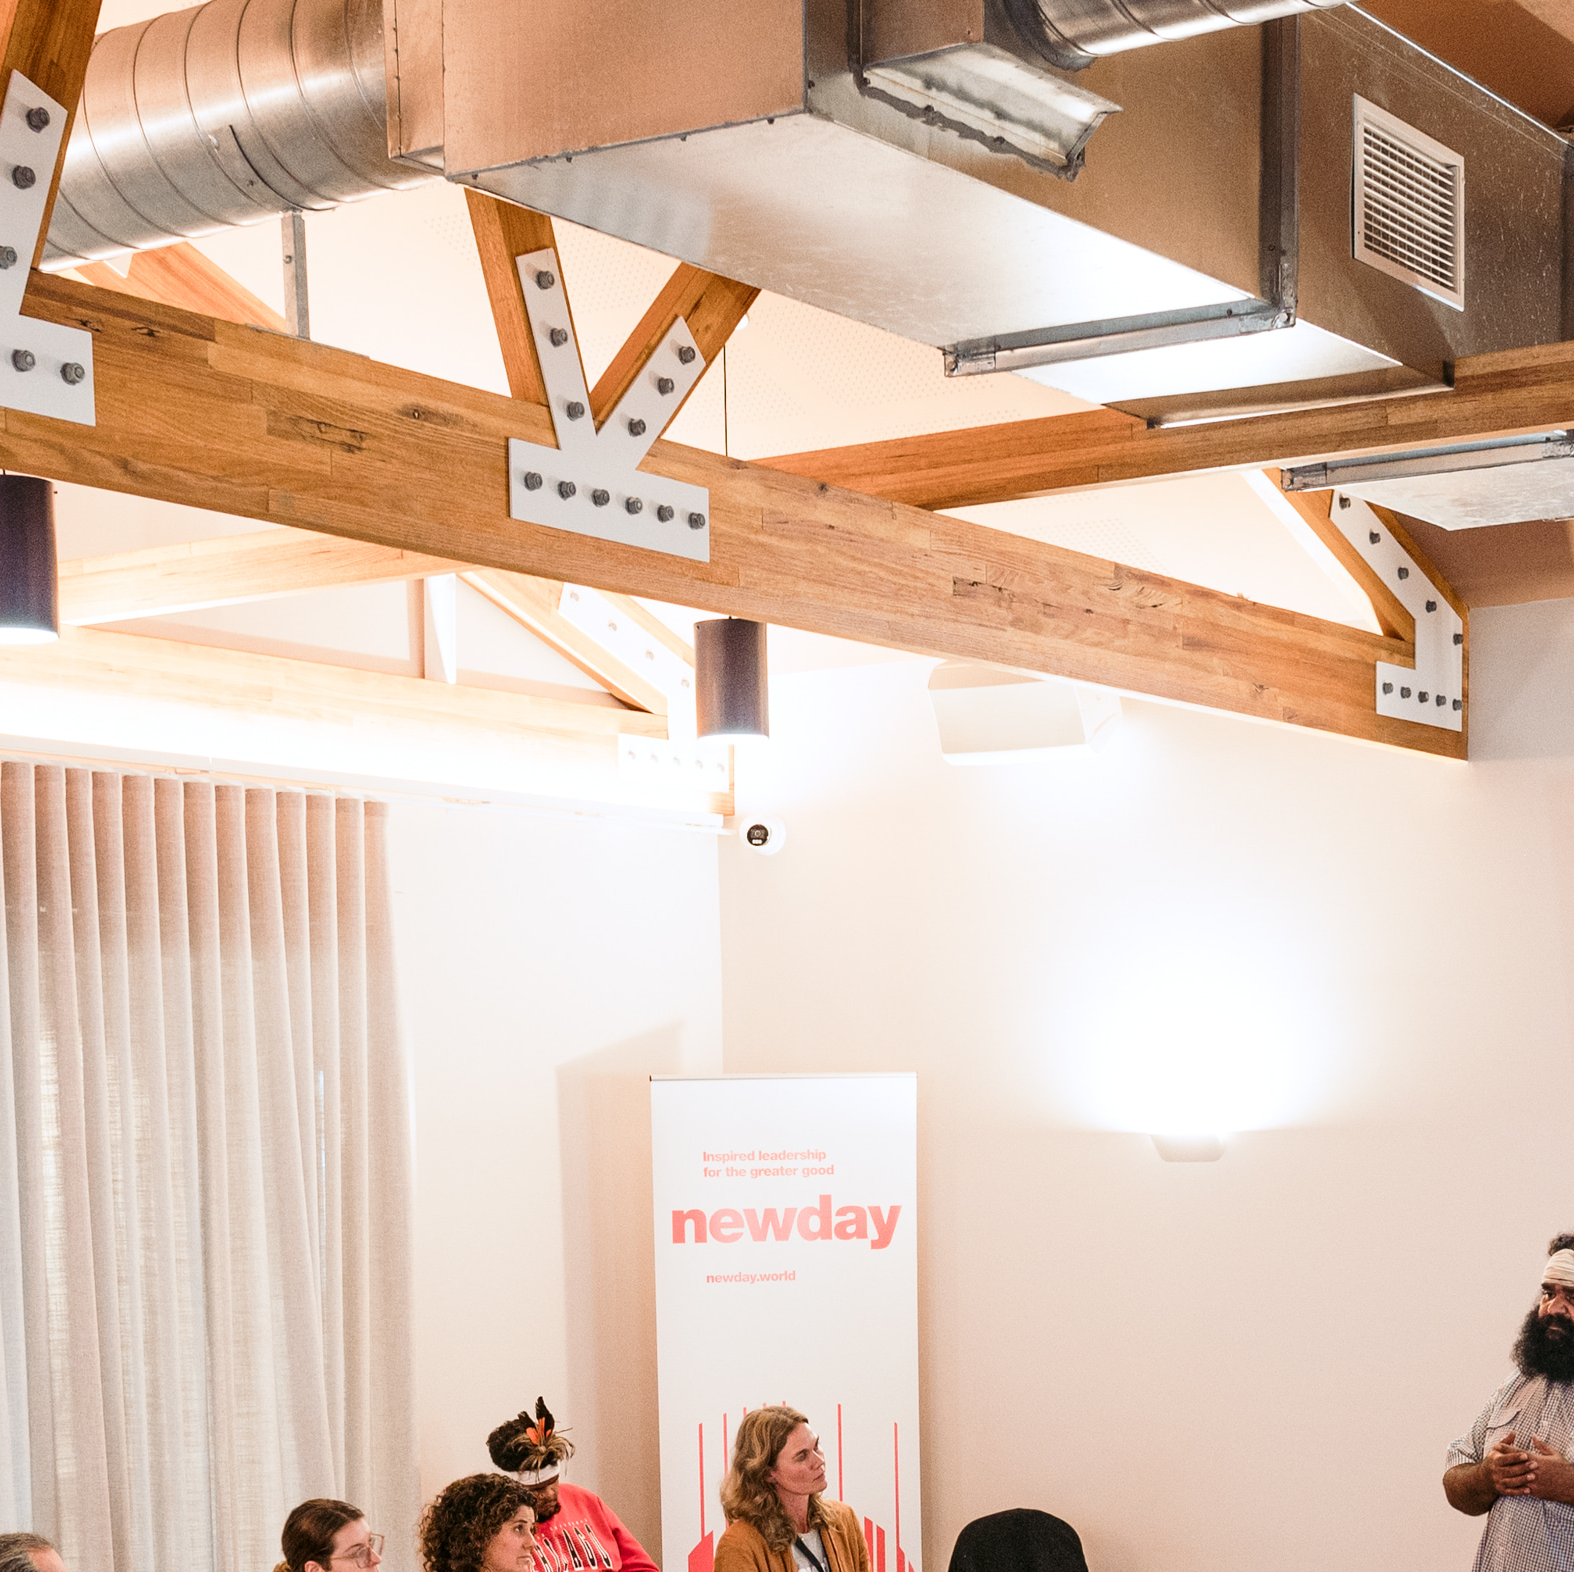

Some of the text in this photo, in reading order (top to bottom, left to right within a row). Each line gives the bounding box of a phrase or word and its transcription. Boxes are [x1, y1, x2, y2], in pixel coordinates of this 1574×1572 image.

[703, 1149, 827, 1164] Inspired leadership
[703, 1164, 835, 1179] for the greater good
[671, 1194, 903, 1250] newday
[706, 1270, 797, 1285] newday.world
